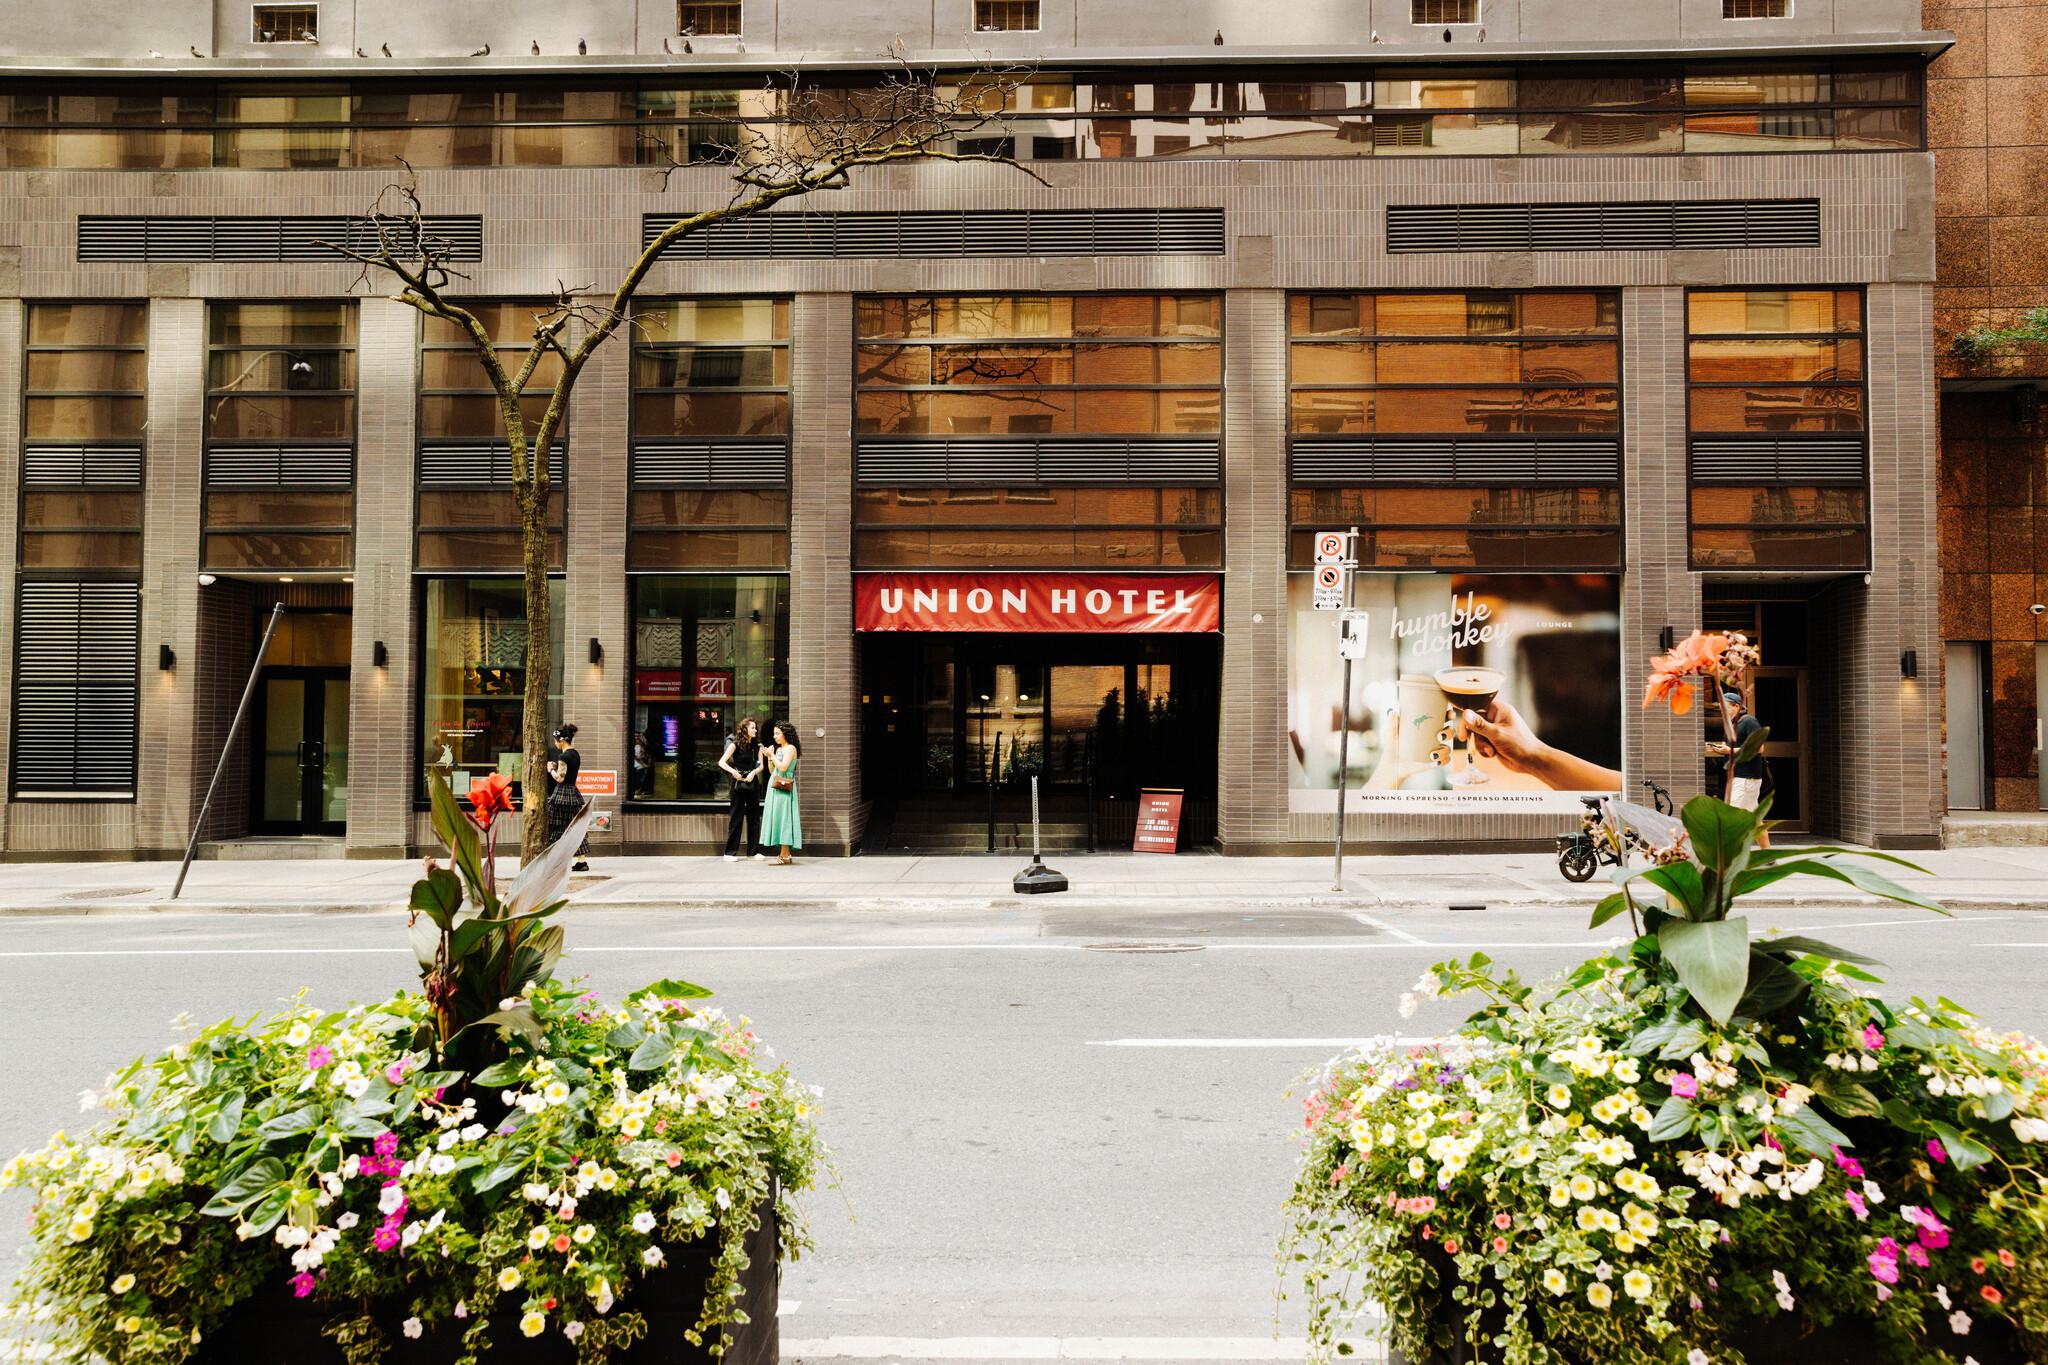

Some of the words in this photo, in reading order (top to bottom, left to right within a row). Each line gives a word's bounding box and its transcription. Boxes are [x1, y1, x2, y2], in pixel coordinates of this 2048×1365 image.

[880, 588, 1028, 614] UNION
[1051, 589, 1193, 614] HOTEL
[1389, 591, 1492, 640] humble
[1411, 622, 1512, 657] donkey
